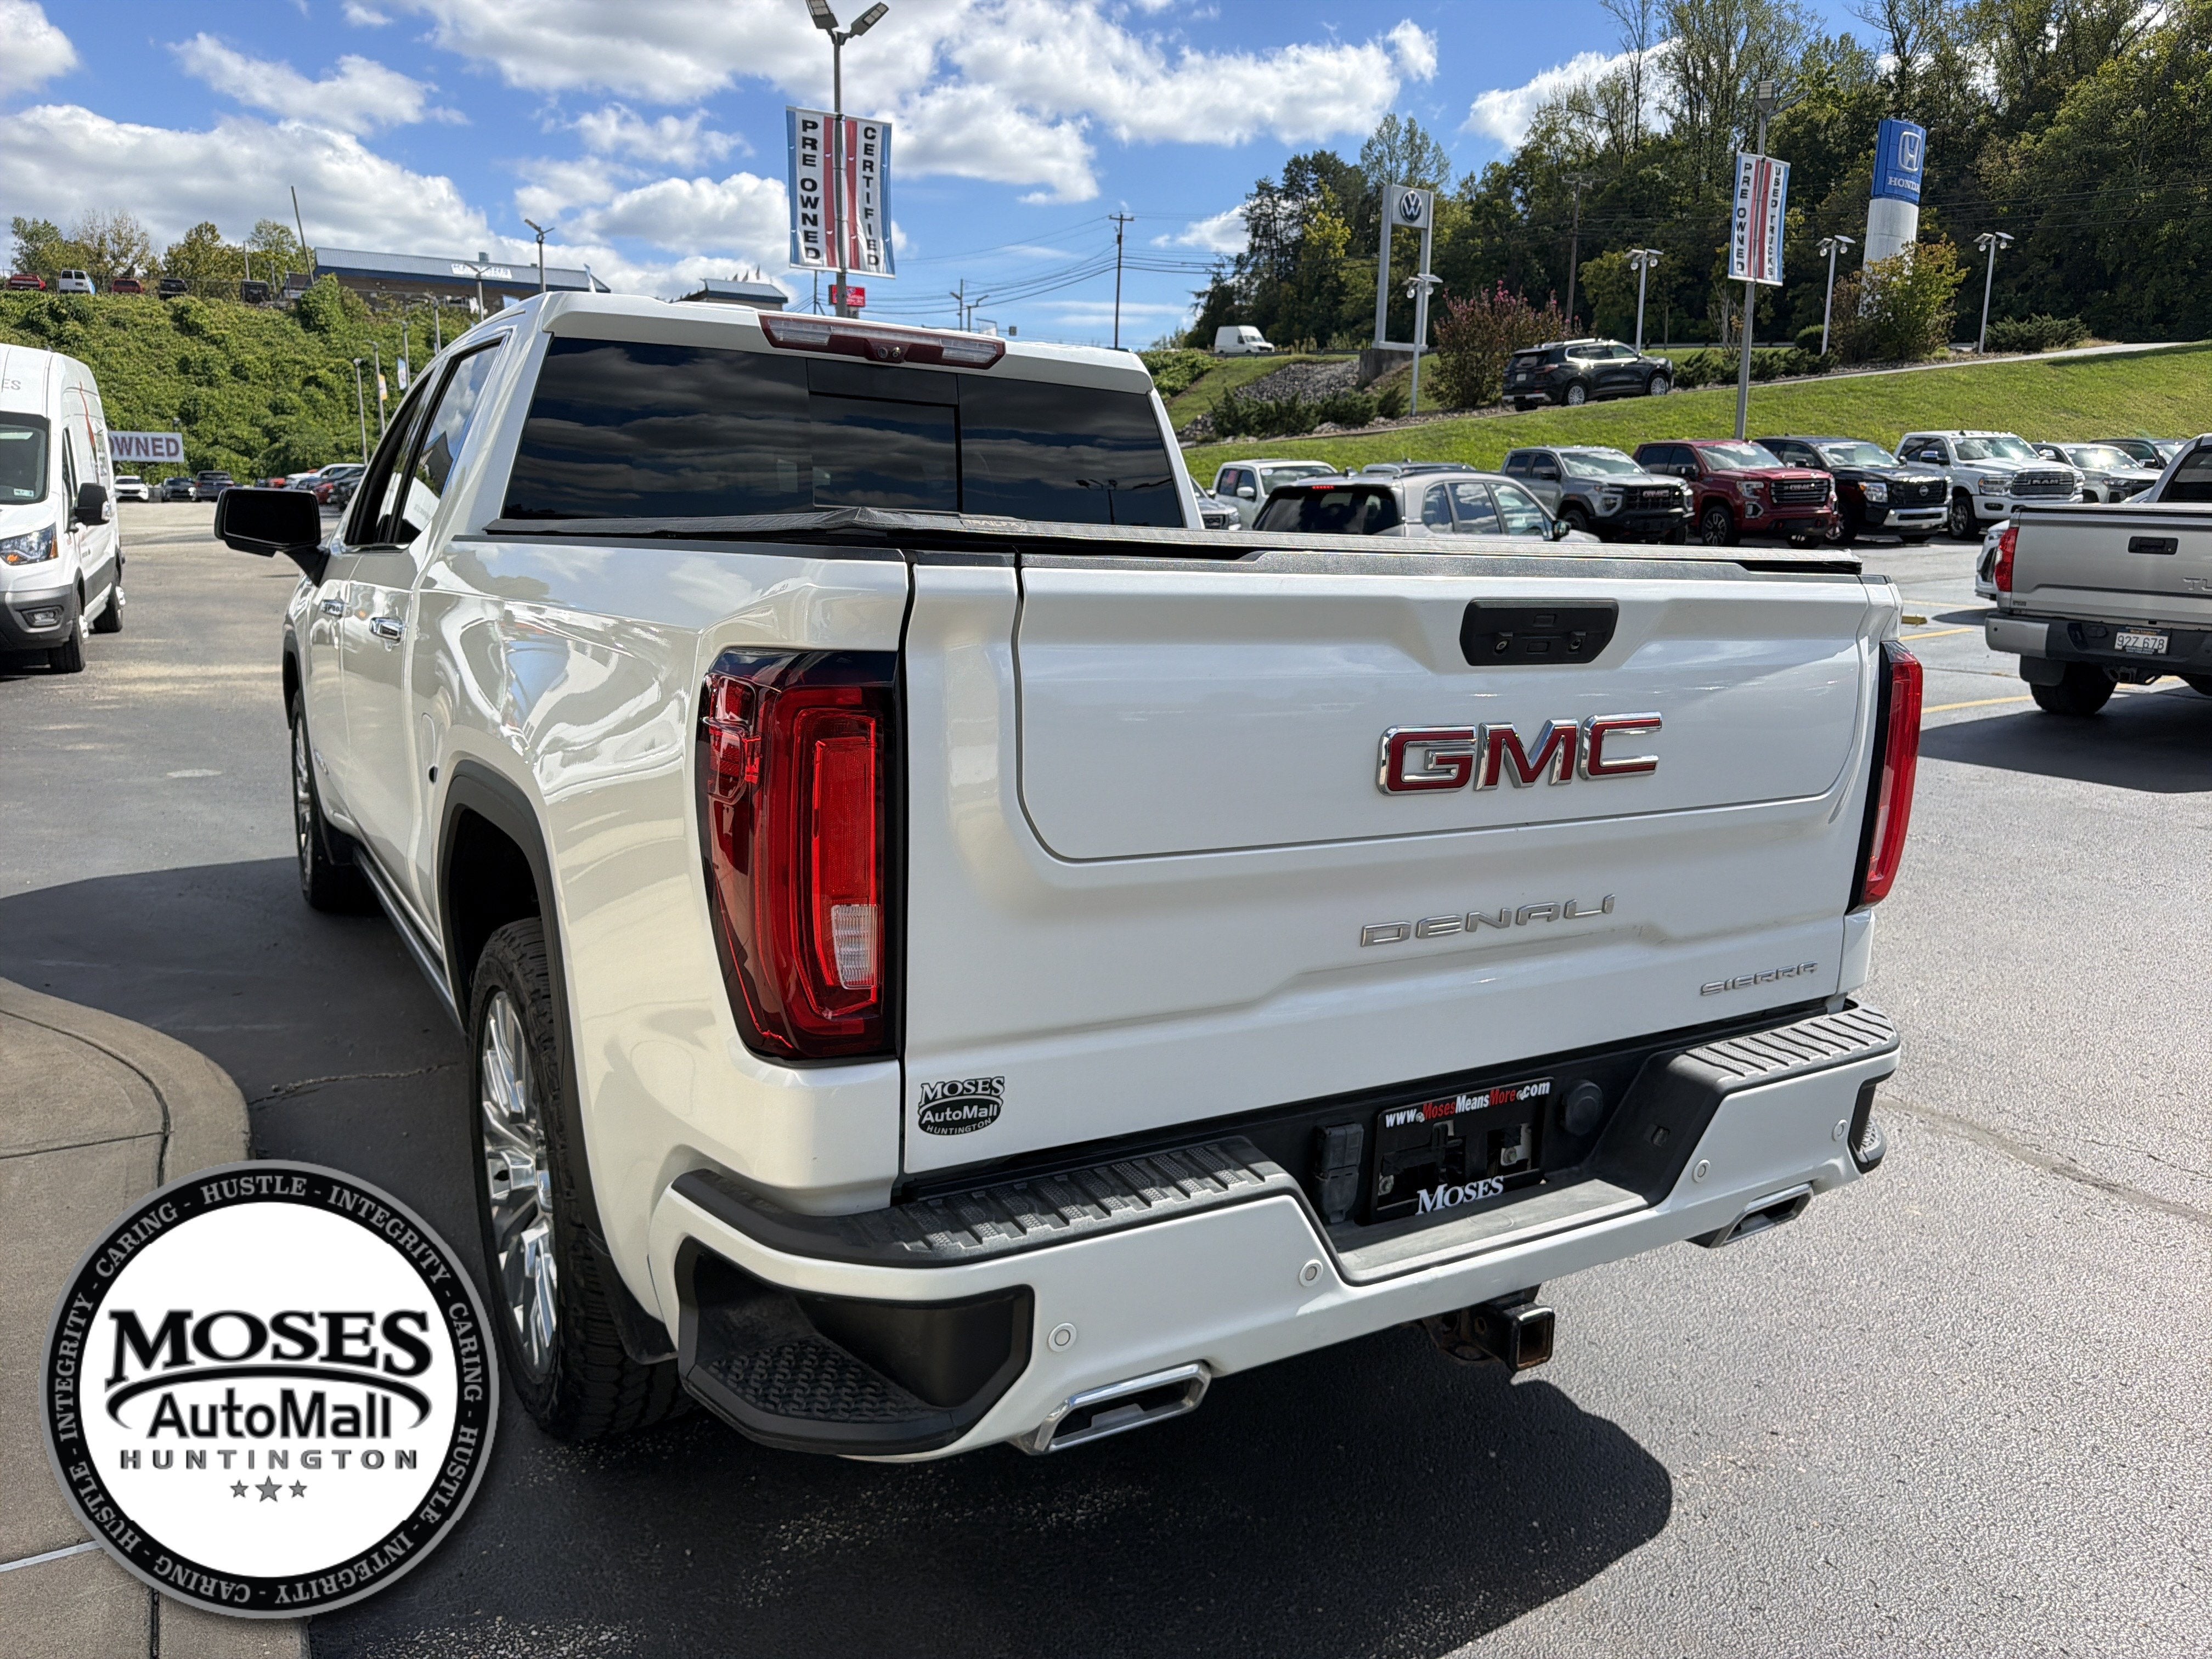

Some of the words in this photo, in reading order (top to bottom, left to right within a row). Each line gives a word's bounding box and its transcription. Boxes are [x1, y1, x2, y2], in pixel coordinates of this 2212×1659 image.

[802, 119, 819, 167] PRE
[862, 126, 880, 266] CERTIFIED
[1739, 162, 1753, 199] PRE
[1771, 166, 1781, 208] USED
[800, 178, 820, 260] OWNED
[1736, 207, 1747, 272] OWNED
[1767, 214, 1776, 276] TRUCKS
[2142, 637, 2165, 651] 678
[1376, 712, 1663, 797] GMC
[1360, 893, 1616, 948] DENALI
[1700, 961, 1819, 996] SIERRA
[919, 1076, 1005, 1107] MOSES
[921, 1104, 998, 1124] AutoMall
[926, 1118, 992, 1135] HUNTINGTON
[1414, 1175, 1505, 1216] MOSES
